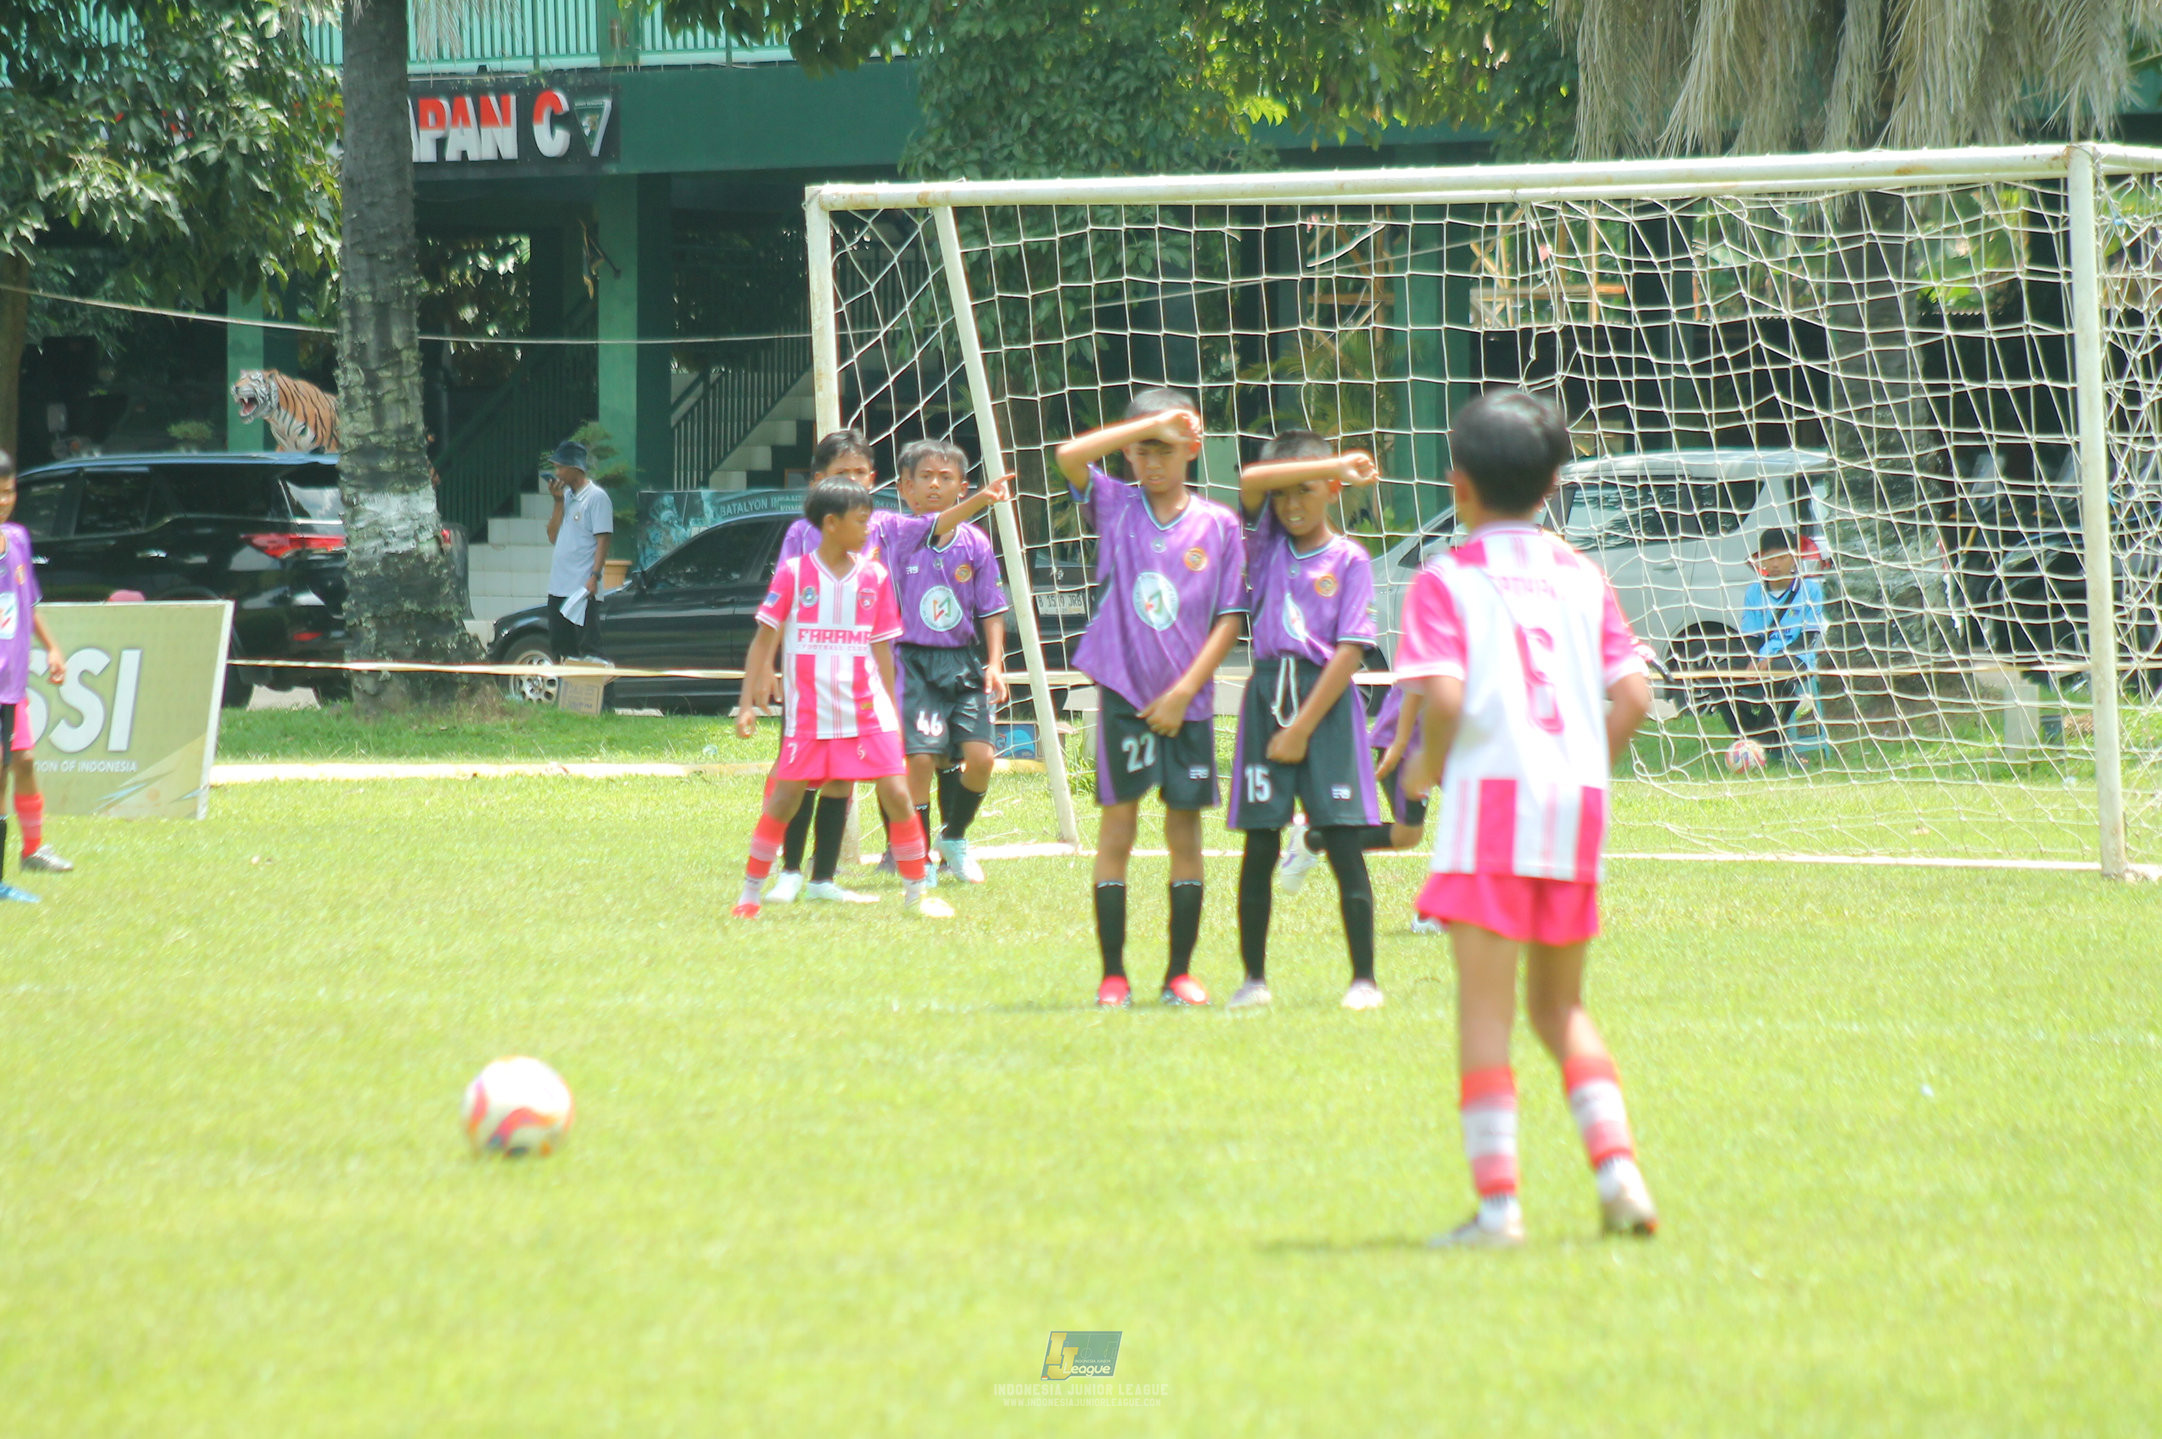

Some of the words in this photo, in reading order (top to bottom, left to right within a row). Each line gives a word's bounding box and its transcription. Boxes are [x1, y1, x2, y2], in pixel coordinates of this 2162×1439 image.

[407, 96, 518, 162] PAN
[532, 90, 571, 157] C
[720, 499, 768, 516] BATALYON
[916, 710, 943, 737] 46
[787, 742, 798, 764] 7
[1121, 731, 1156, 773] 22
[61, 760, 76, 772] OF
[78, 760, 137, 772] INDONESIA
[1244, 765, 1272, 803] 15
